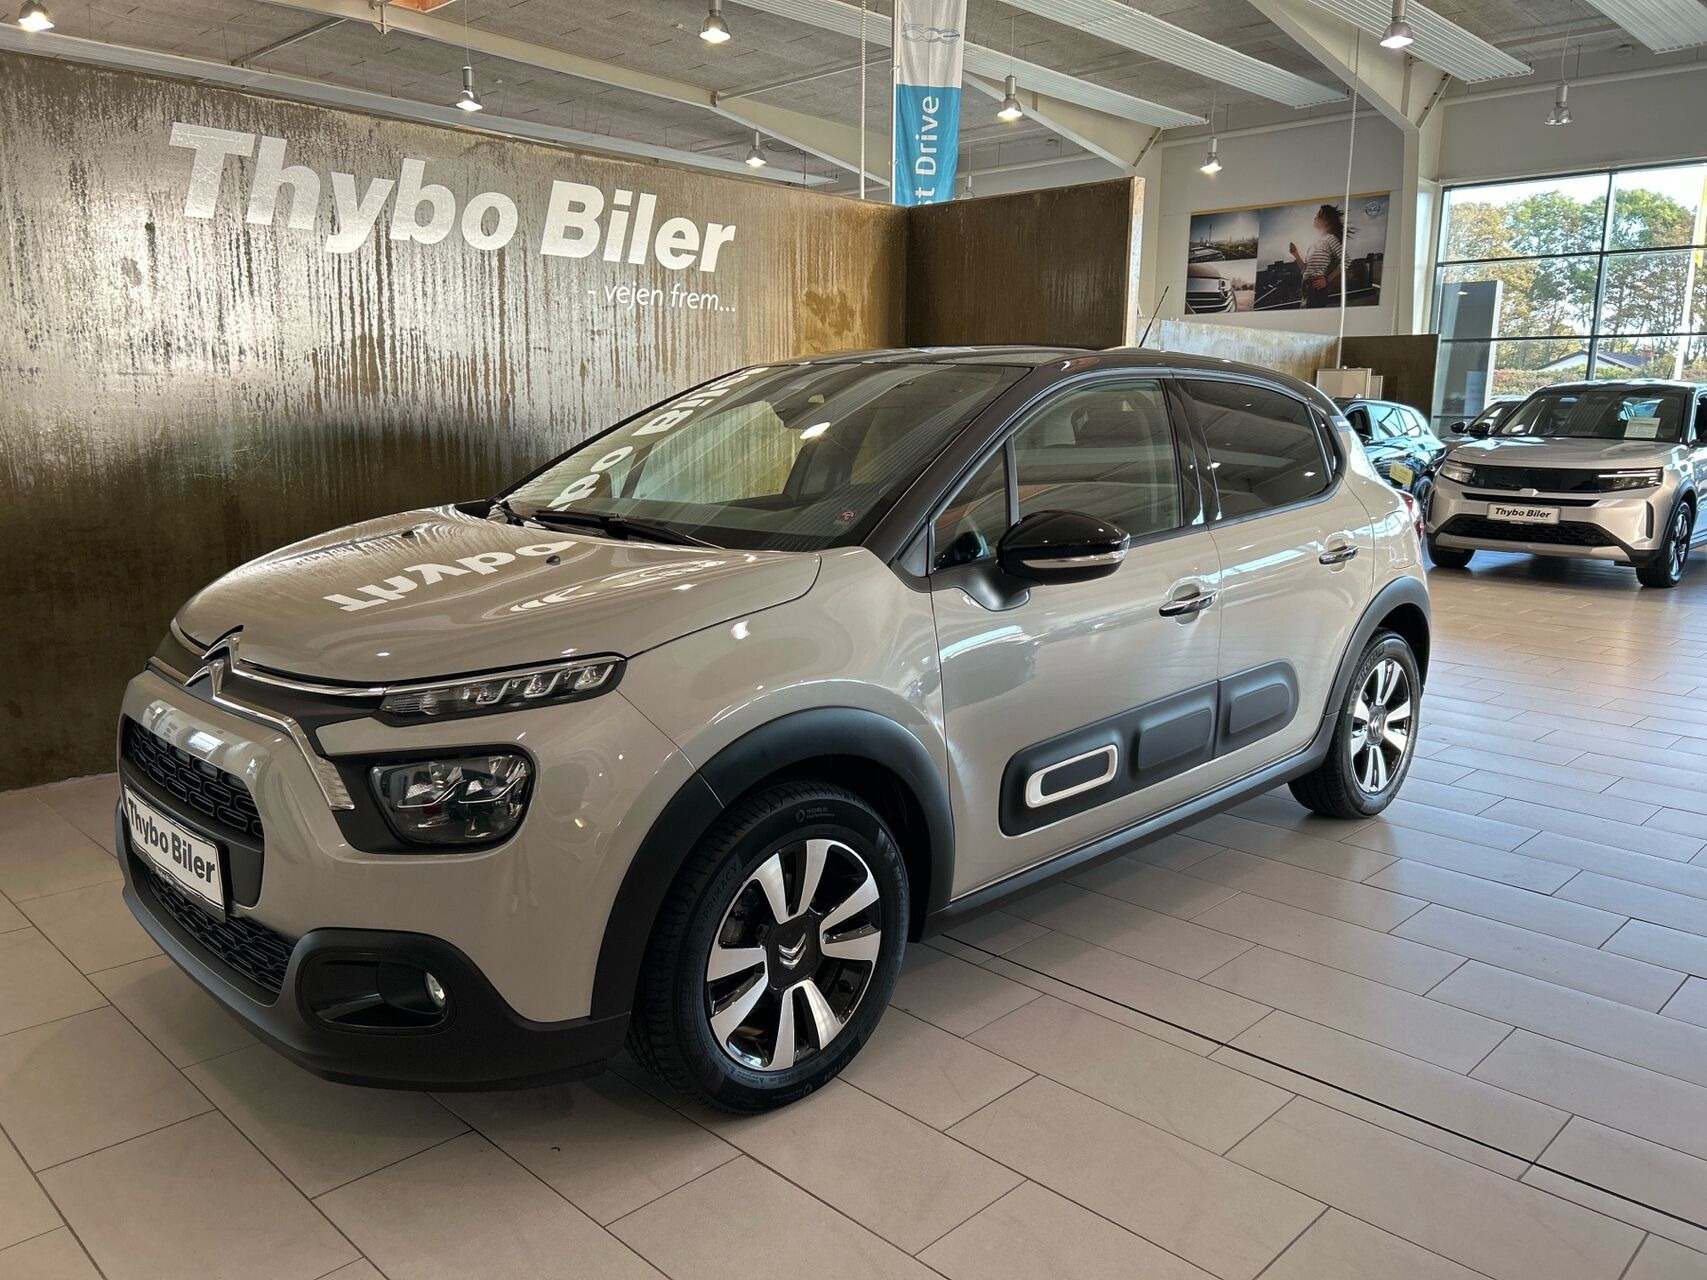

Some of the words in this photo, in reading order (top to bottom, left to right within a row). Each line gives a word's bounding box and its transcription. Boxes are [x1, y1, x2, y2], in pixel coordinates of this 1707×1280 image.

[915, 95, 939, 176] Drive
[169, 122, 518, 254] Thybo
[540, 180, 736, 273] Biler
[605, 281, 664, 310] vejen
[671, 283, 736, 312] frem...
[1495, 507, 1525, 517] Thybo
[1526, 509, 1552, 518] Biler
[128, 797, 169, 854] Thybo
[171, 831, 216, 884] Biler
